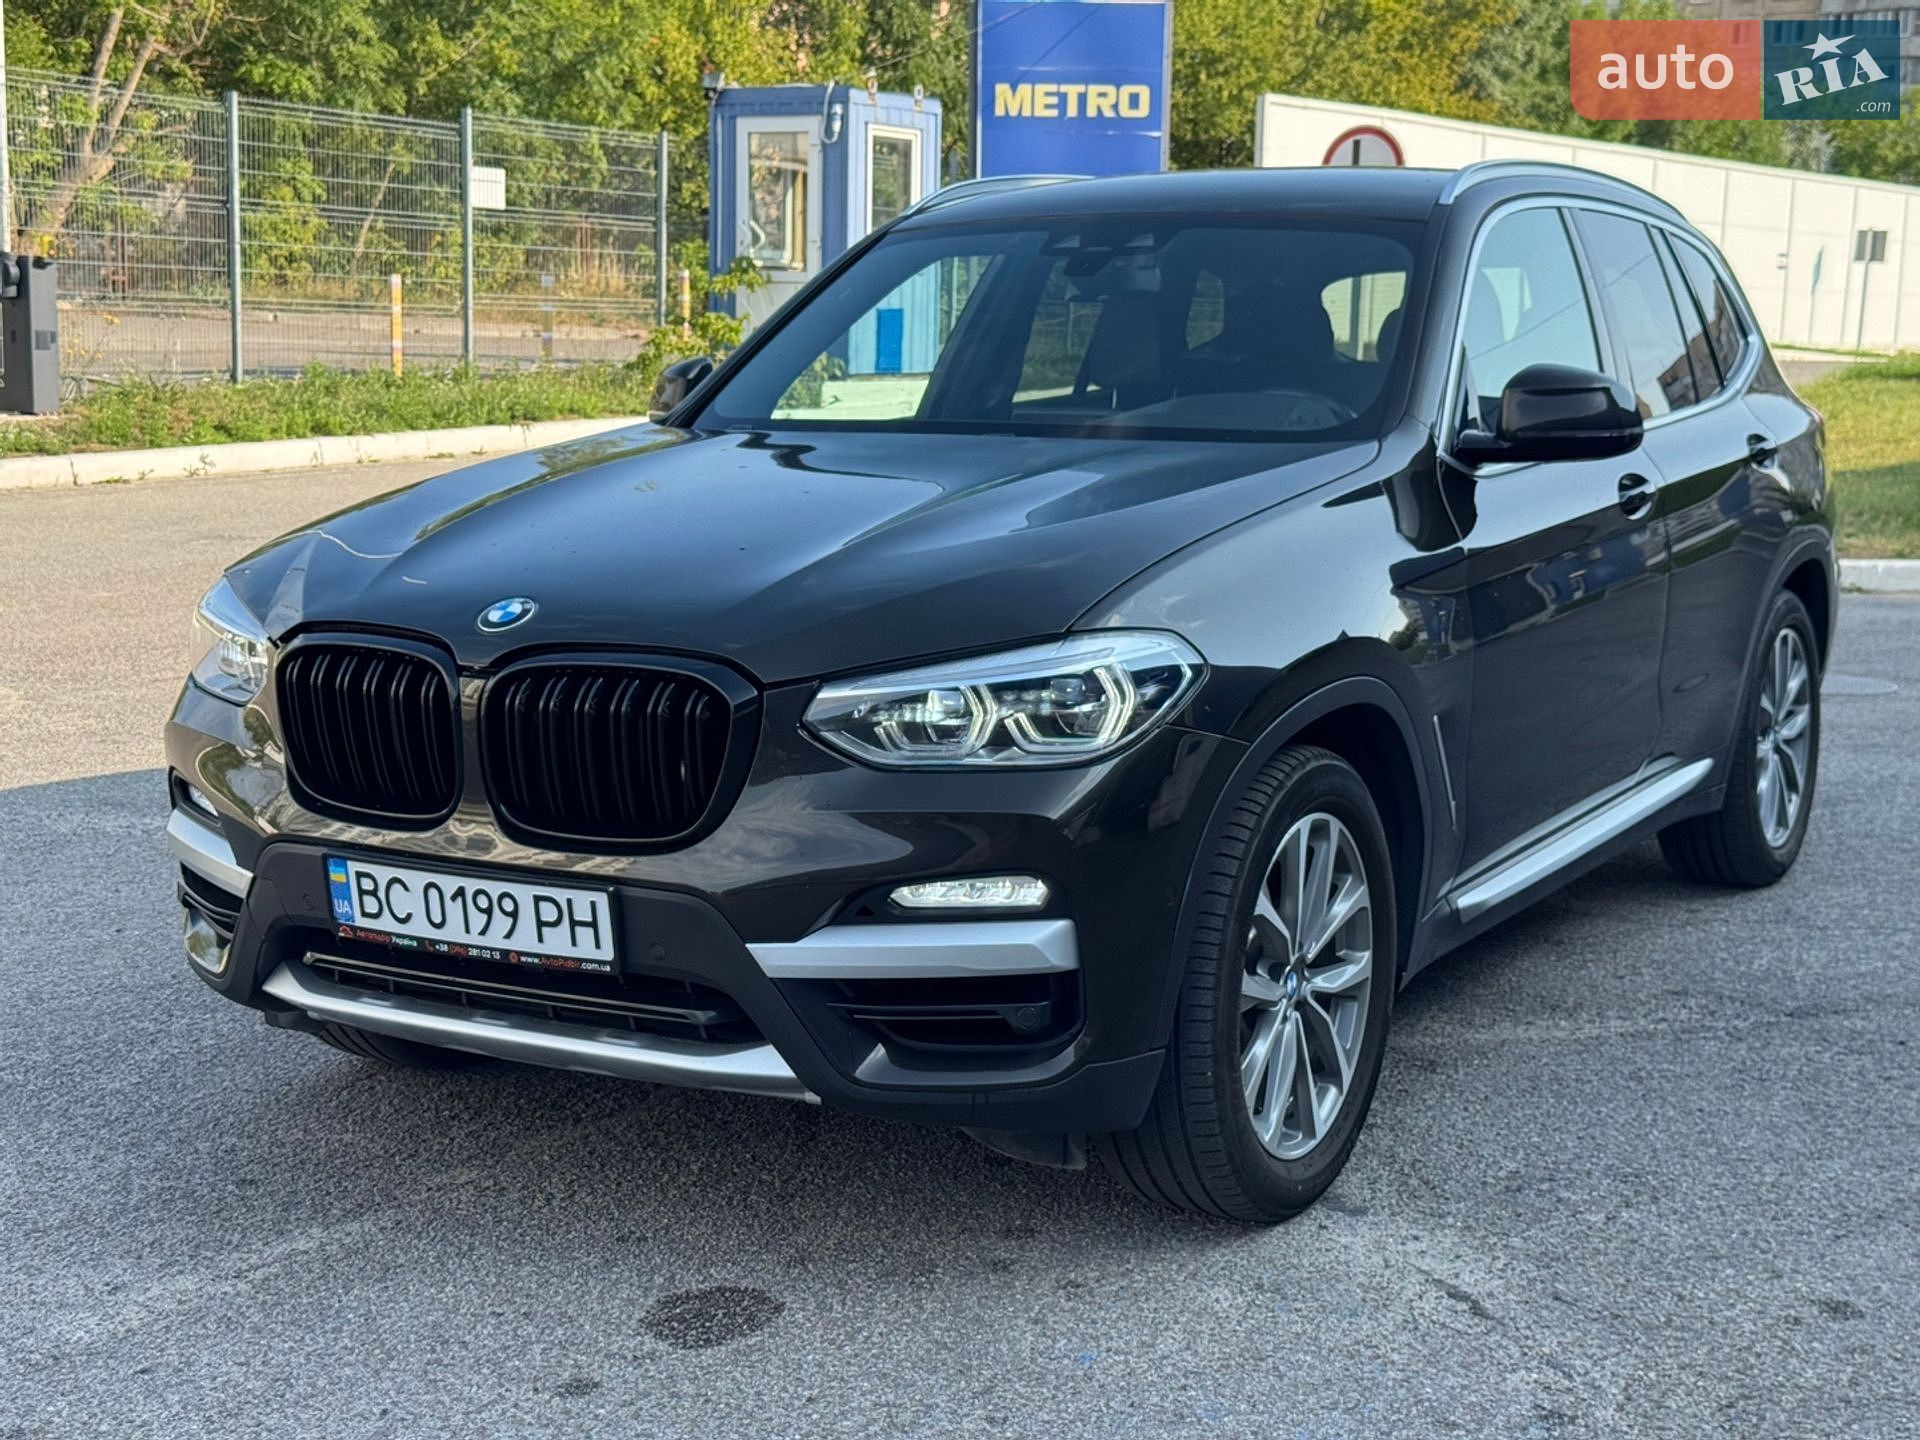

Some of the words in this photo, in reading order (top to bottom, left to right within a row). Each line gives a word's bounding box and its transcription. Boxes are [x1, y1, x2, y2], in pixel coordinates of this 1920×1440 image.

[994, 83, 1151, 118] METRO
[334, 898, 352, 914] UA
[355, 870, 413, 924] BC
[422, 881, 519, 939] 0199
[532, 894, 601, 950] PH
